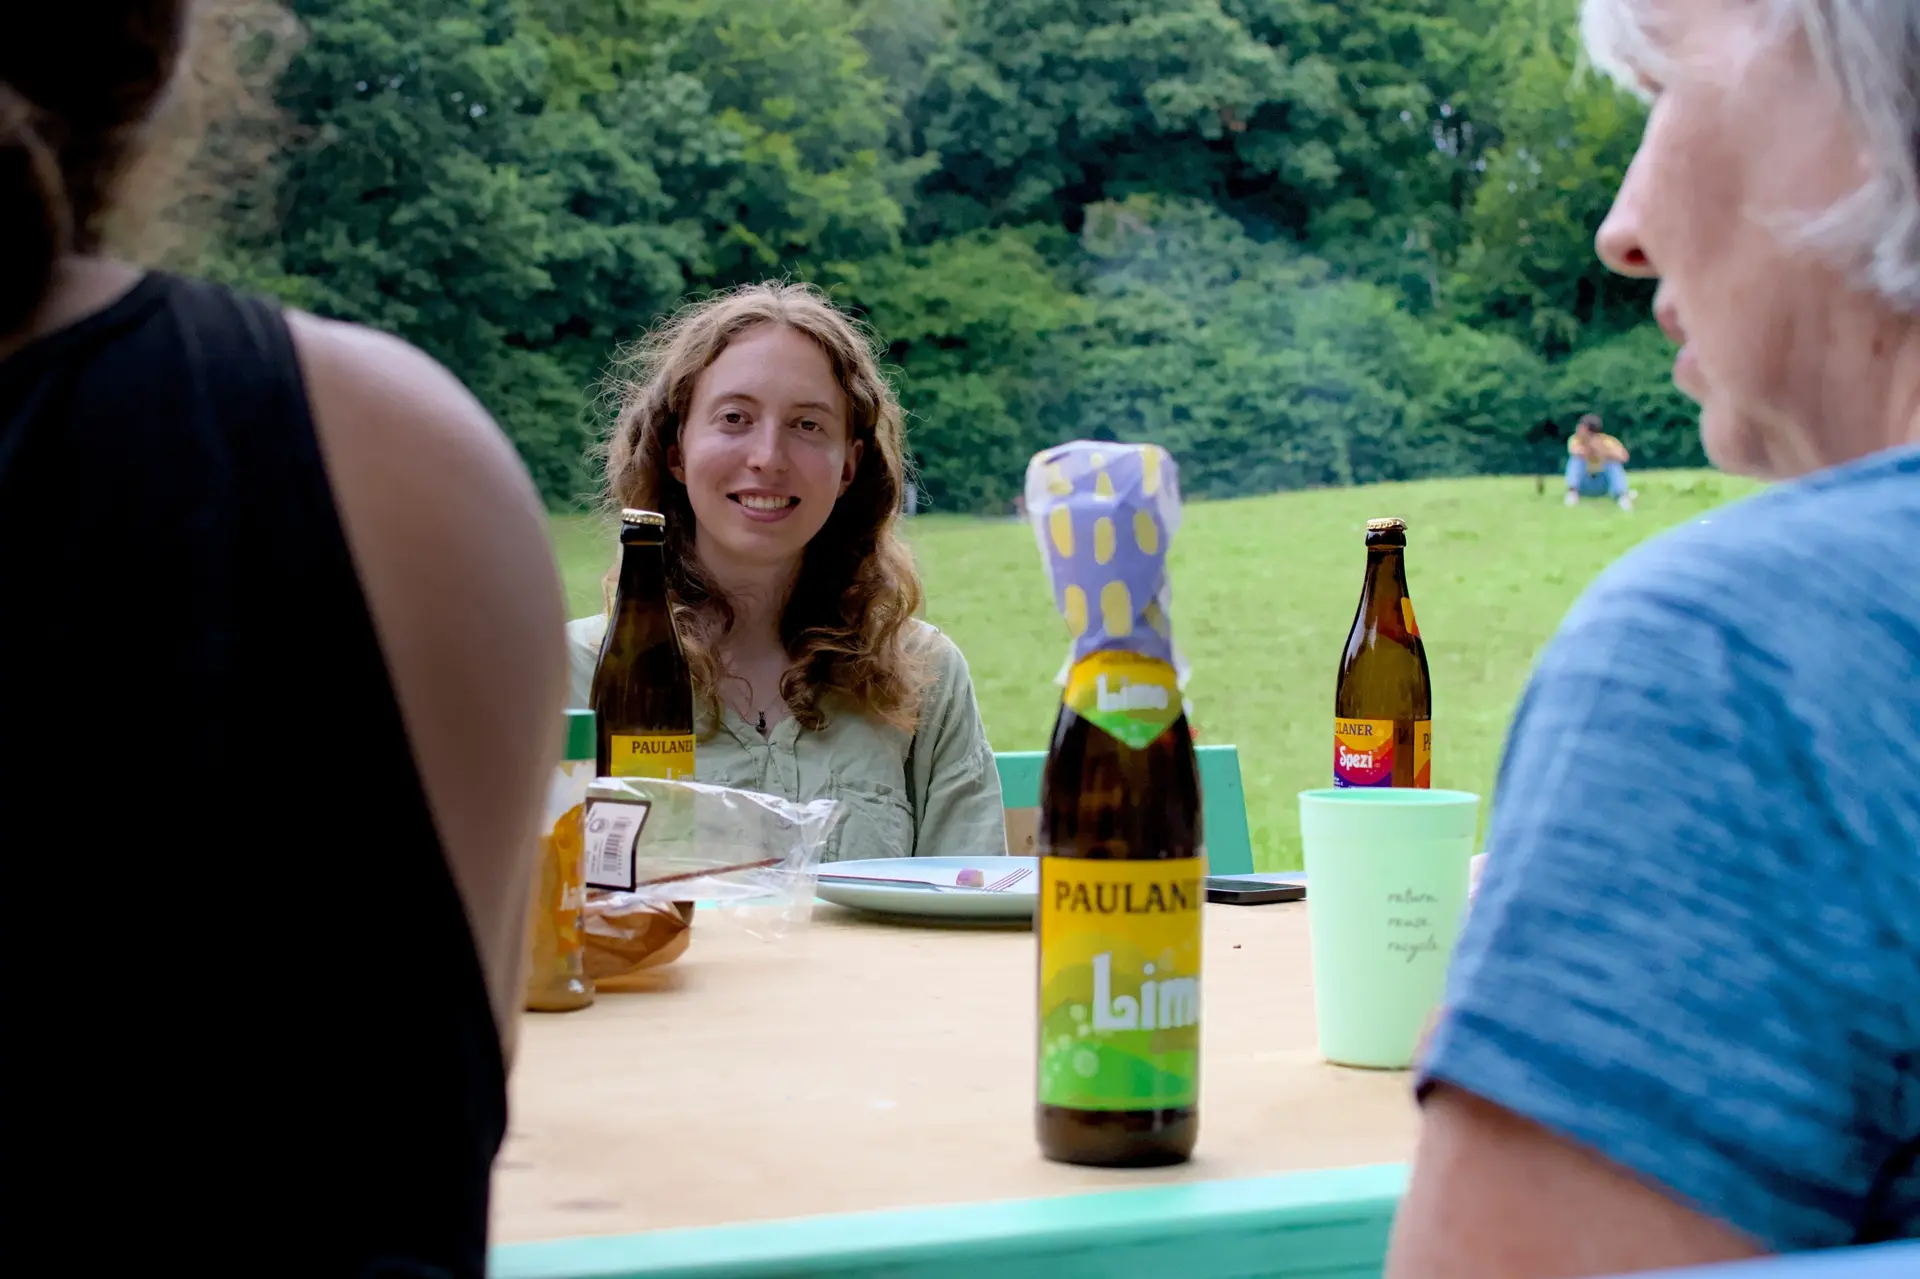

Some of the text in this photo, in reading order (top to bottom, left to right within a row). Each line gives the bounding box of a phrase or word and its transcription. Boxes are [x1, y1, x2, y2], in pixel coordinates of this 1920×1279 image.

[1336, 722, 1373, 736] LANER
[1339, 745, 1373, 771] Spezi
[1055, 878, 1200, 914] PAULAN
[1092, 951, 1200, 1030] Lim
